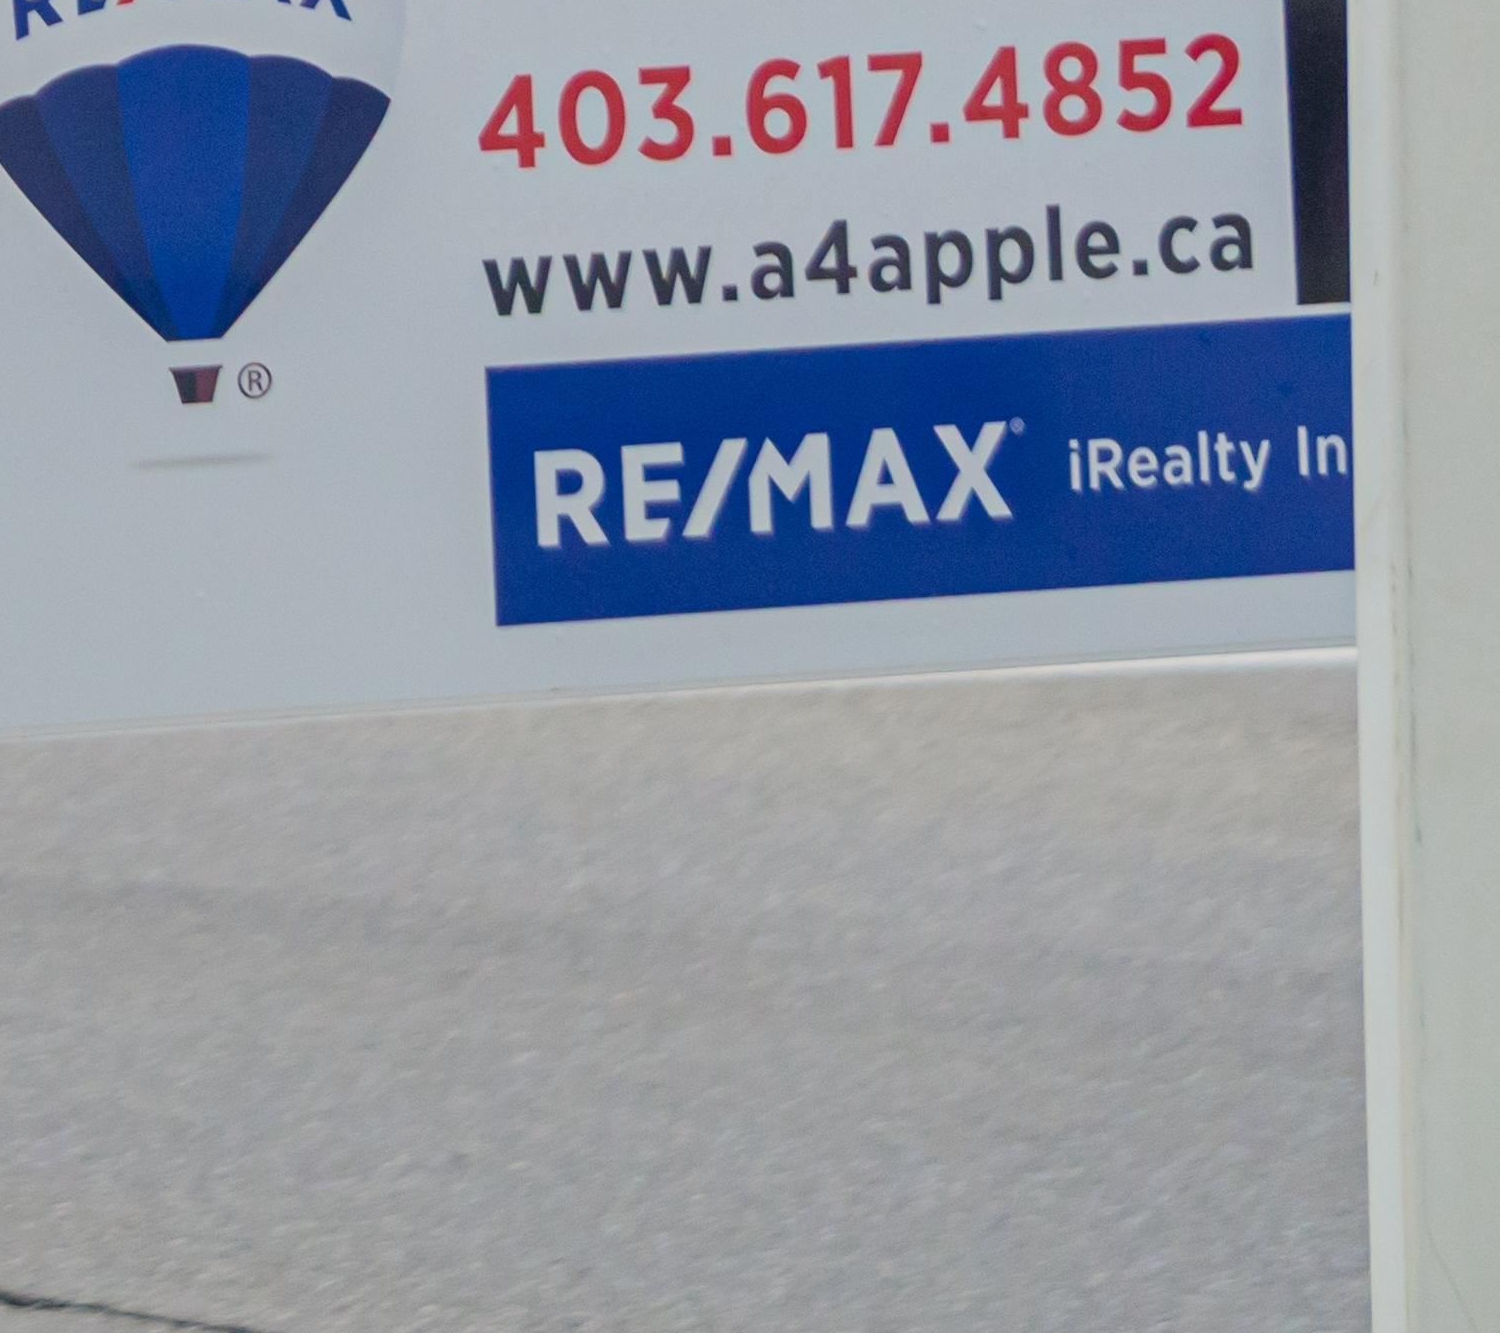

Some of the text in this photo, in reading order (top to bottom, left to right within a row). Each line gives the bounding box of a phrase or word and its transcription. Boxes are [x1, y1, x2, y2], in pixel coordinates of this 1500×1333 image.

[478, 32, 1244, 170] 403.617.4852
[483, 203, 1255, 317] www.a4apple.ca
[1067, 429, 1271, 493] iRealty
